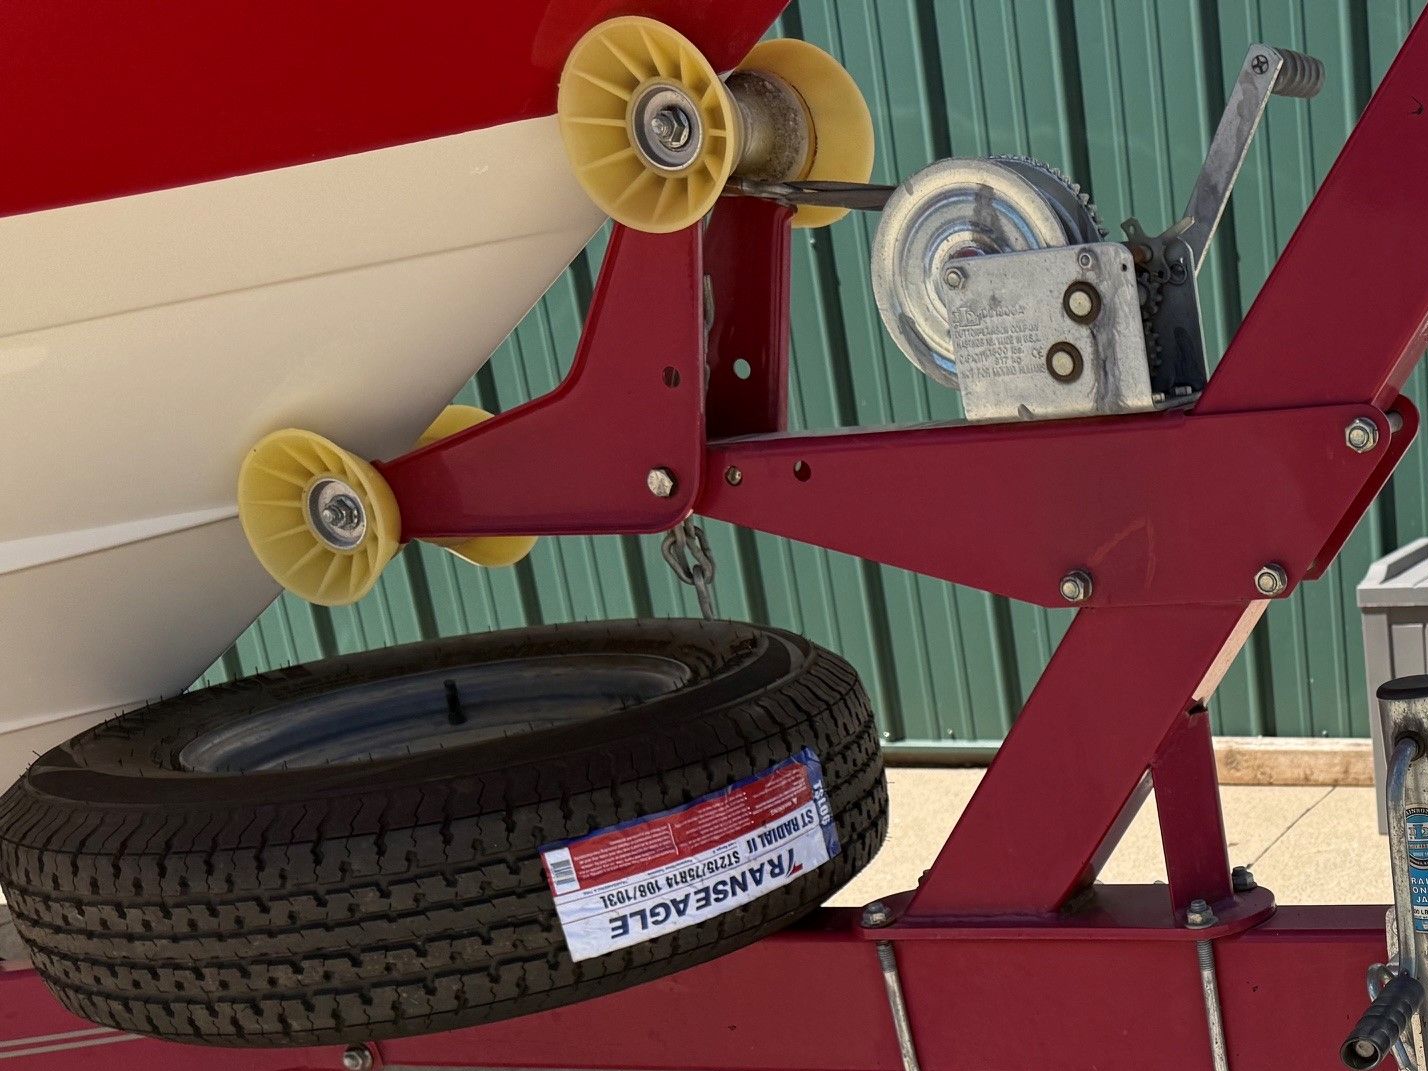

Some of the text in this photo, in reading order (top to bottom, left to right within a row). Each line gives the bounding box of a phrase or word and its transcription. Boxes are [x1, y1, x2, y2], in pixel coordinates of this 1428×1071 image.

[759, 814, 800, 846] RADIAL
[799, 808, 815, 829] ST
[665, 850, 741, 888] ST215/75R14
[600, 874, 663, 909] 108/103L
[609, 848, 804, 940] TRANSEAGLE
